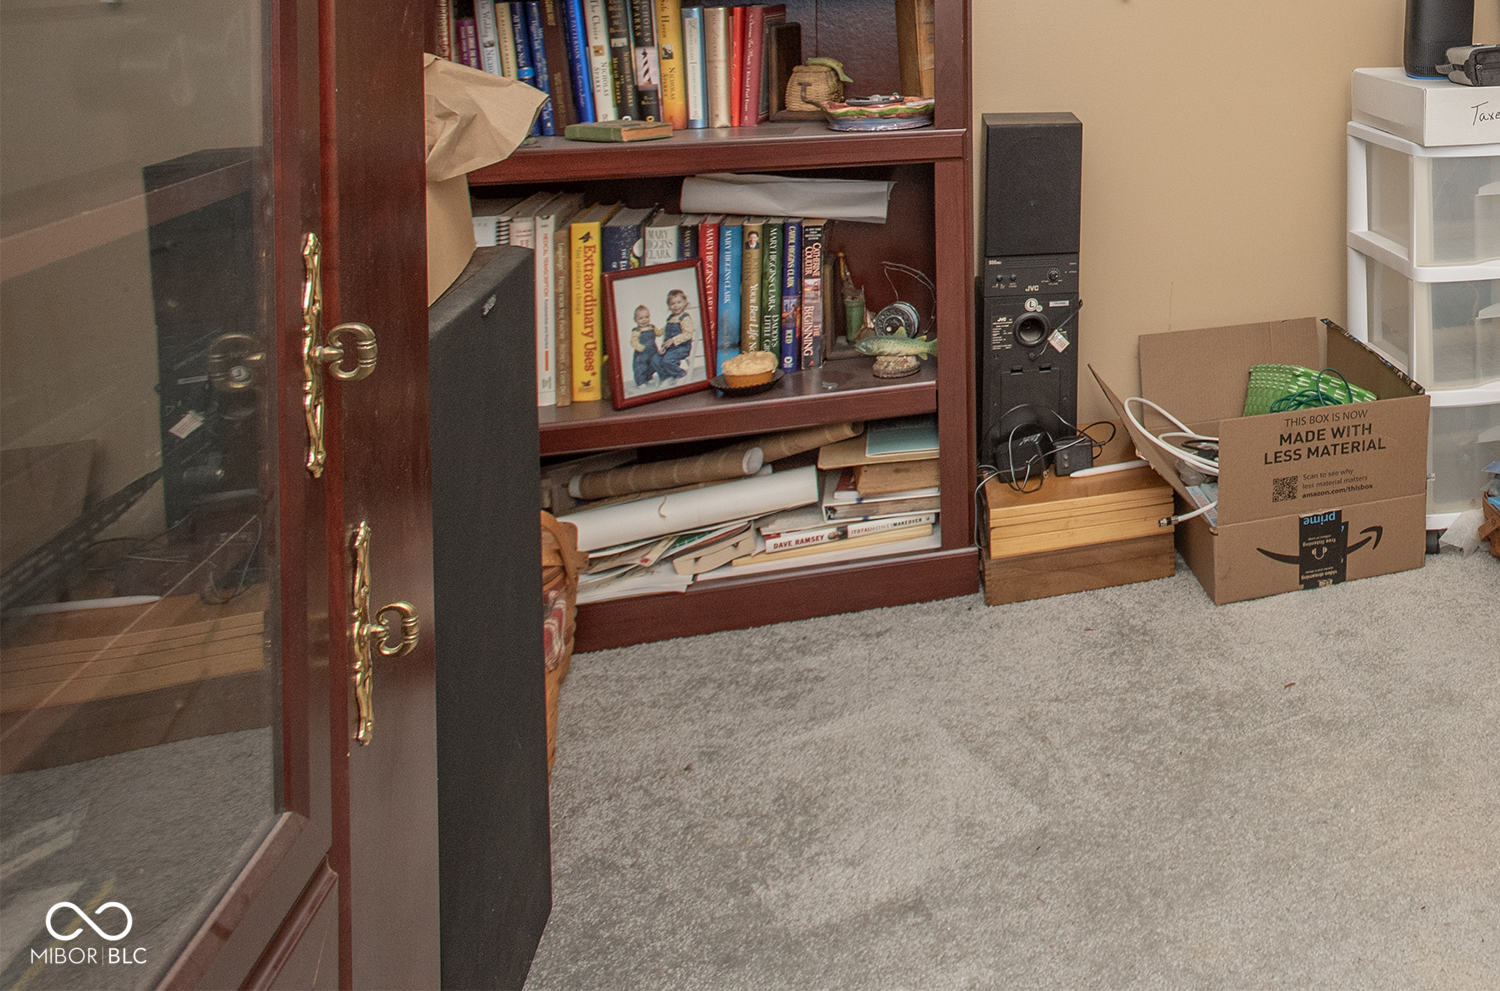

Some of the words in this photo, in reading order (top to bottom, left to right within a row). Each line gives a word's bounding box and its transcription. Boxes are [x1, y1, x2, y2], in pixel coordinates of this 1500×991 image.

[590, 0, 599, 12] The
[591, 15, 600, 40] Choice
[633, 0, 641, 37] SPARKS
[661, 15, 669, 38] Haven
[514, 24, 522, 44] Through
[593, 67, 601, 93] SPARKS
[601, 62, 609, 96] NICHOLAS
[667, 67, 676, 100] NICHOLAS
[648, 230, 668, 238] MARY
[706, 228, 714, 250] MARY
[770, 227, 778, 249] MARY
[788, 225, 796, 243] CAROL
[646, 250, 671, 258] CLARK
[787, 245, 796, 268] HIGGINS
[804, 246, 813, 275] COULTER
[812, 242, 821, 277] CATHERINE
[769, 251, 777, 284] HIGGINS
[787, 269, 795, 287] CLARK
[582, 244, 597, 338] Extraordinary
[768, 284, 777, 311] CLARK
[750, 305, 759, 322] Best
[747, 323, 759, 340] Life
[771, 314, 779, 347] DADDY'S
[785, 329, 793, 344] ICED
[803, 306, 814, 356] BEGINNING
[813, 324, 821, 337] THE
[1285, 416, 1307, 428] THIS
[1309, 414, 1330, 425] BOX
[1332, 413, 1341, 422] IS
[1342, 409, 1369, 420] NOW
[1279, 428, 1326, 446] MADE
[1331, 423, 1373, 439] WITH
[1264, 448, 1302, 465] LESS
[1306, 437, 1387, 459] MATERIAL
[1302, 482, 1315, 490] less
[1316, 478, 1342, 488] material
[1343, 474, 1368, 485] matters
[1303, 473, 1318, 481] Scan
[1340, 468, 1354, 476] why
[1302, 482, 1373, 499] amazon.com/thisbox
[1303, 511, 1335, 525] prime
[773, 540, 792, 549] DAVE
[795, 535, 824, 545] RAMSEY
